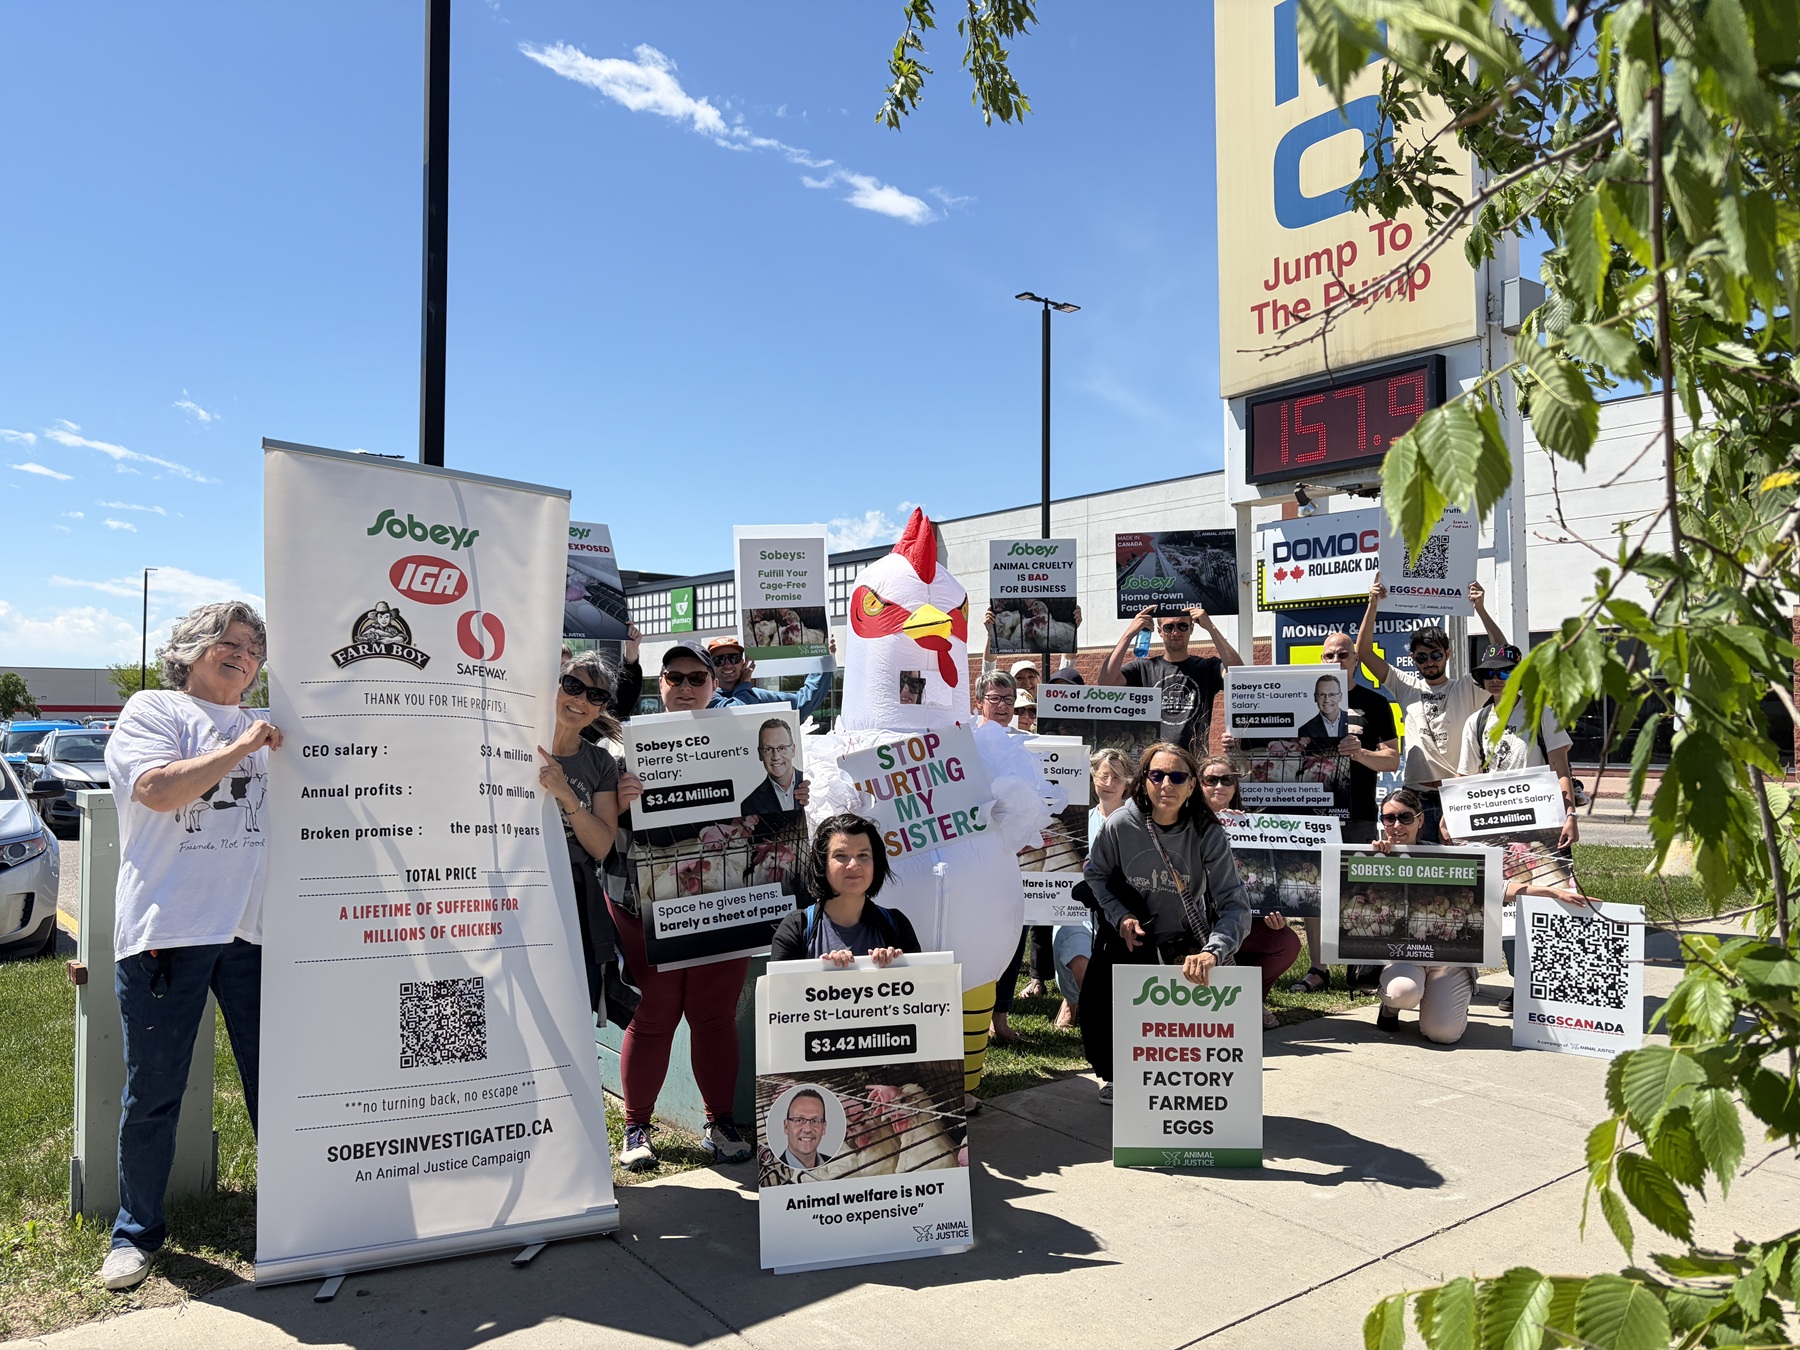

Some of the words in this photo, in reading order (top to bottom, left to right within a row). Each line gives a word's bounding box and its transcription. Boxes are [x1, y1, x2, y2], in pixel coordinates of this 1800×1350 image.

[1264, 239, 1357, 292] Jump
[1369, 214, 1412, 256] To
[1250, 298, 1312, 336] The
[1324, 259, 1432, 309] Pump
[1281, 374, 1424, 464] 157.9
[367, 509, 480, 551] Sobeys
[568, 543, 610, 553] EXPOSED
[760, 550, 805, 561] Sobeys:
[1007, 542, 1059, 558] Sobeys
[758, 569, 784, 578] Fulfill
[993, 562, 1030, 570] ANIMAL
[1031, 561, 1074, 570] CRUELTY
[1309, 558, 1362, 577] ROLLBACK
[398, 563, 461, 596] IGA
[759, 581, 807, 591] Cage-Free
[1121, 574, 1176, 591] Sobeys
[765, 592, 802, 601] Promise
[1021, 585, 1066, 593] BUSINESS
[1390, 585, 1462, 596] EGGSCANADA
[672, 617, 692, 627] pharmacy
[1282, 623, 1346, 638] MONDAY
[1349, 623, 1359, 633] &
[1376, 617, 1441, 633] HURSDAY
[336, 644, 386, 664] FARM
[392, 645, 428, 664] BOY
[457, 663, 506, 680] SAFEWAY
[1045, 689, 1068, 699] 80%
[1070, 690, 1080, 699] of
[1083, 687, 1127, 703] Sobeys
[1129, 693, 1154, 704] Eggs
[1231, 683, 1262, 692] Sobeys
[364, 692, 400, 705] THANK
[404, 693, 425, 706] YOU
[429, 694, 448, 706] FOR
[451, 695, 468, 708] THE
[1232, 702, 1260, 710] Salary:
[1054, 703, 1085, 713] Come
[1086, 704, 1112, 714] from
[1113, 706, 1146, 717] Cages
[1261, 716, 1291, 724] Million
[635, 740, 683, 752] Sobeys
[685, 735, 710, 747] CEO
[876, 733, 940, 770] STOP
[303, 745, 329, 758] CEO
[334, 743, 378, 758] salary
[480, 744, 501, 758] $3.4
[504, 749, 533, 763] million
[637, 756, 673, 767] Pierre
[639, 768, 682, 783] Salary:
[854, 757, 965, 801] HURTING
[301, 784, 349, 799] Annual
[355, 783, 402, 799] profits
[479, 782, 503, 796] $700
[506, 786, 535, 799] million
[646, 791, 684, 807] $3.42
[685, 787, 729, 801] Million
[1467, 788, 1506, 799] Sobeys
[1508, 784, 1530, 794] CEO
[1524, 794, 1555, 803] Salary:
[894, 788, 934, 823] MY
[1473, 816, 1499, 826] $3.42
[1499, 813, 1532, 823] Million
[301, 826, 349, 840] Broken
[355, 824, 413, 841] promise
[450, 821, 470, 834] the
[475, 823, 498, 836] past
[501, 823, 512, 835] 10
[514, 827, 540, 838] years
[884, 806, 988, 856] SISTERS
[179, 840, 217, 853] Friends,
[221, 838, 238, 849] Not
[242, 836, 265, 847] Food
[405, 868, 441, 883] TOTAL
[446, 867, 477, 881] PRICE
[1351, 864, 1395, 876] SOBEYS:
[1398, 865, 1413, 877] GO
[1416, 866, 1475, 879] CAGE-FREE
[339, 906, 348, 920] A
[353, 903, 411, 919] LIFETIME
[416, 902, 432, 916] OF
[437, 898, 498, 914] SUFFERING
[501, 898, 519, 911] FOR
[658, 903, 696, 919] Space
[699, 900, 714, 910] he
[716, 895, 747, 910] gives
[749, 890, 778, 902] hens:
[660, 917, 700, 932] barely
[702, 917, 710, 925] a
[712, 909, 745, 923] sheet
[747, 906, 758, 917] of
[760, 903, 793, 919] paper
[364, 926, 426, 944] MILLIONS
[430, 925, 446, 939] OF
[451, 922, 503, 938] CHICKENS
[805, 985, 874, 1004] Sobeys
[877, 981, 914, 997] CEO
[1133, 976, 1242, 1011] Sobeys
[769, 1011, 810, 1025] Pierre
[903, 1002, 950, 1016] Salary:
[1142, 1022, 1234, 1038] PREMIUM
[1527, 1012, 1624, 1033] EGGSCANADA
[811, 1036, 855, 1054] $3.42
[858, 1032, 910, 1049] Million
[1133, 1046, 1201, 1062] PRICES
[1206, 1047, 1243, 1062] FOR
[1143, 1071, 1234, 1087] FACTORY
[382, 1096, 425, 1111] turning
[430, 1091, 460, 1106] back,
[464, 1091, 478, 1102] no
[482, 1085, 518, 1100] escape
[1149, 1095, 1228, 1111] FARMED
[1163, 1120, 1214, 1135] EGGS
[328, 1118, 553, 1162] SOBEYSINVESTIGATED.CA
[355, 1170, 372, 1182] An
[376, 1162, 419, 1180] Animal
[423, 1158, 468, 1173] Justice
[472, 1149, 530, 1167] Campaign
[786, 1193, 840, 1211] Animal
[843, 1188, 898, 1204] welfare
[901, 1188, 912, 1198] is
[915, 1182, 944, 1197] NOT
[936, 1221, 968, 1231] ANIMAL
[935, 1229, 969, 1241] JUSTICE
